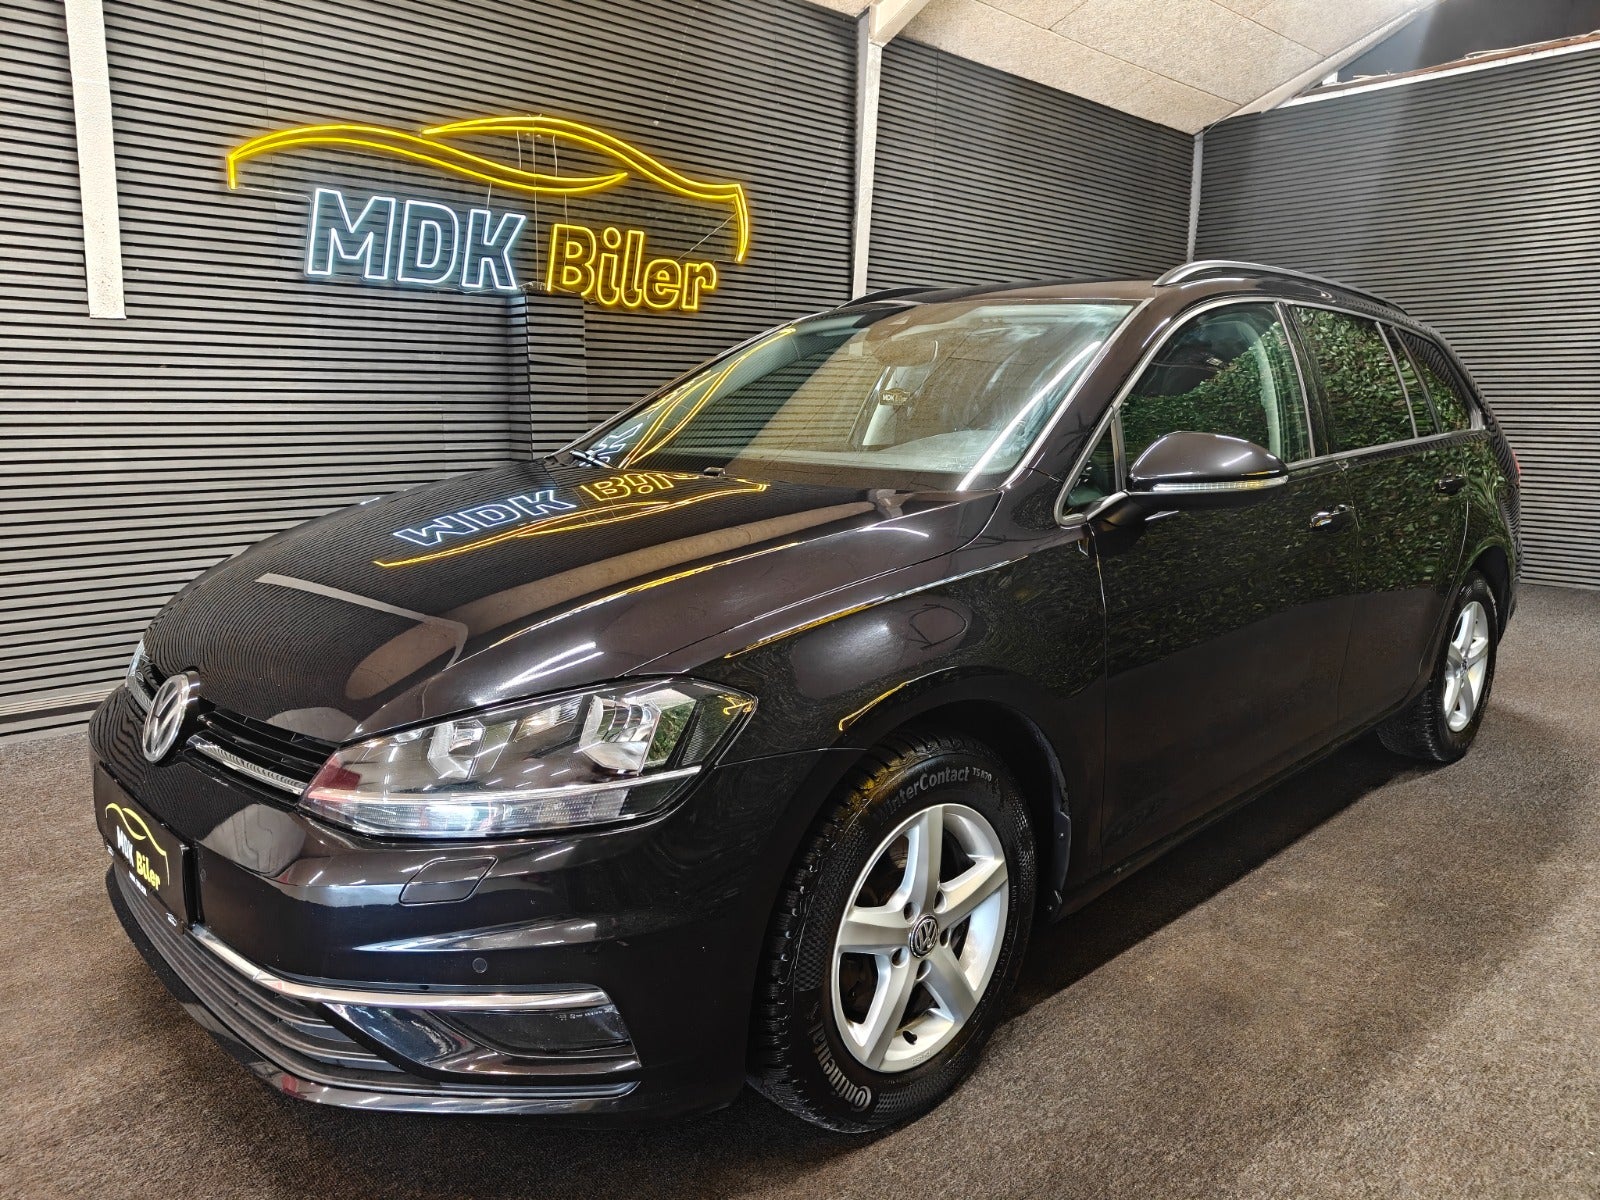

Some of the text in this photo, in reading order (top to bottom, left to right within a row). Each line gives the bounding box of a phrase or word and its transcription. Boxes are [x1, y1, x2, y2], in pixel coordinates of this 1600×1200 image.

[307, 187, 717, 310] MDK Biler
[136, 850, 160, 891] Biler
